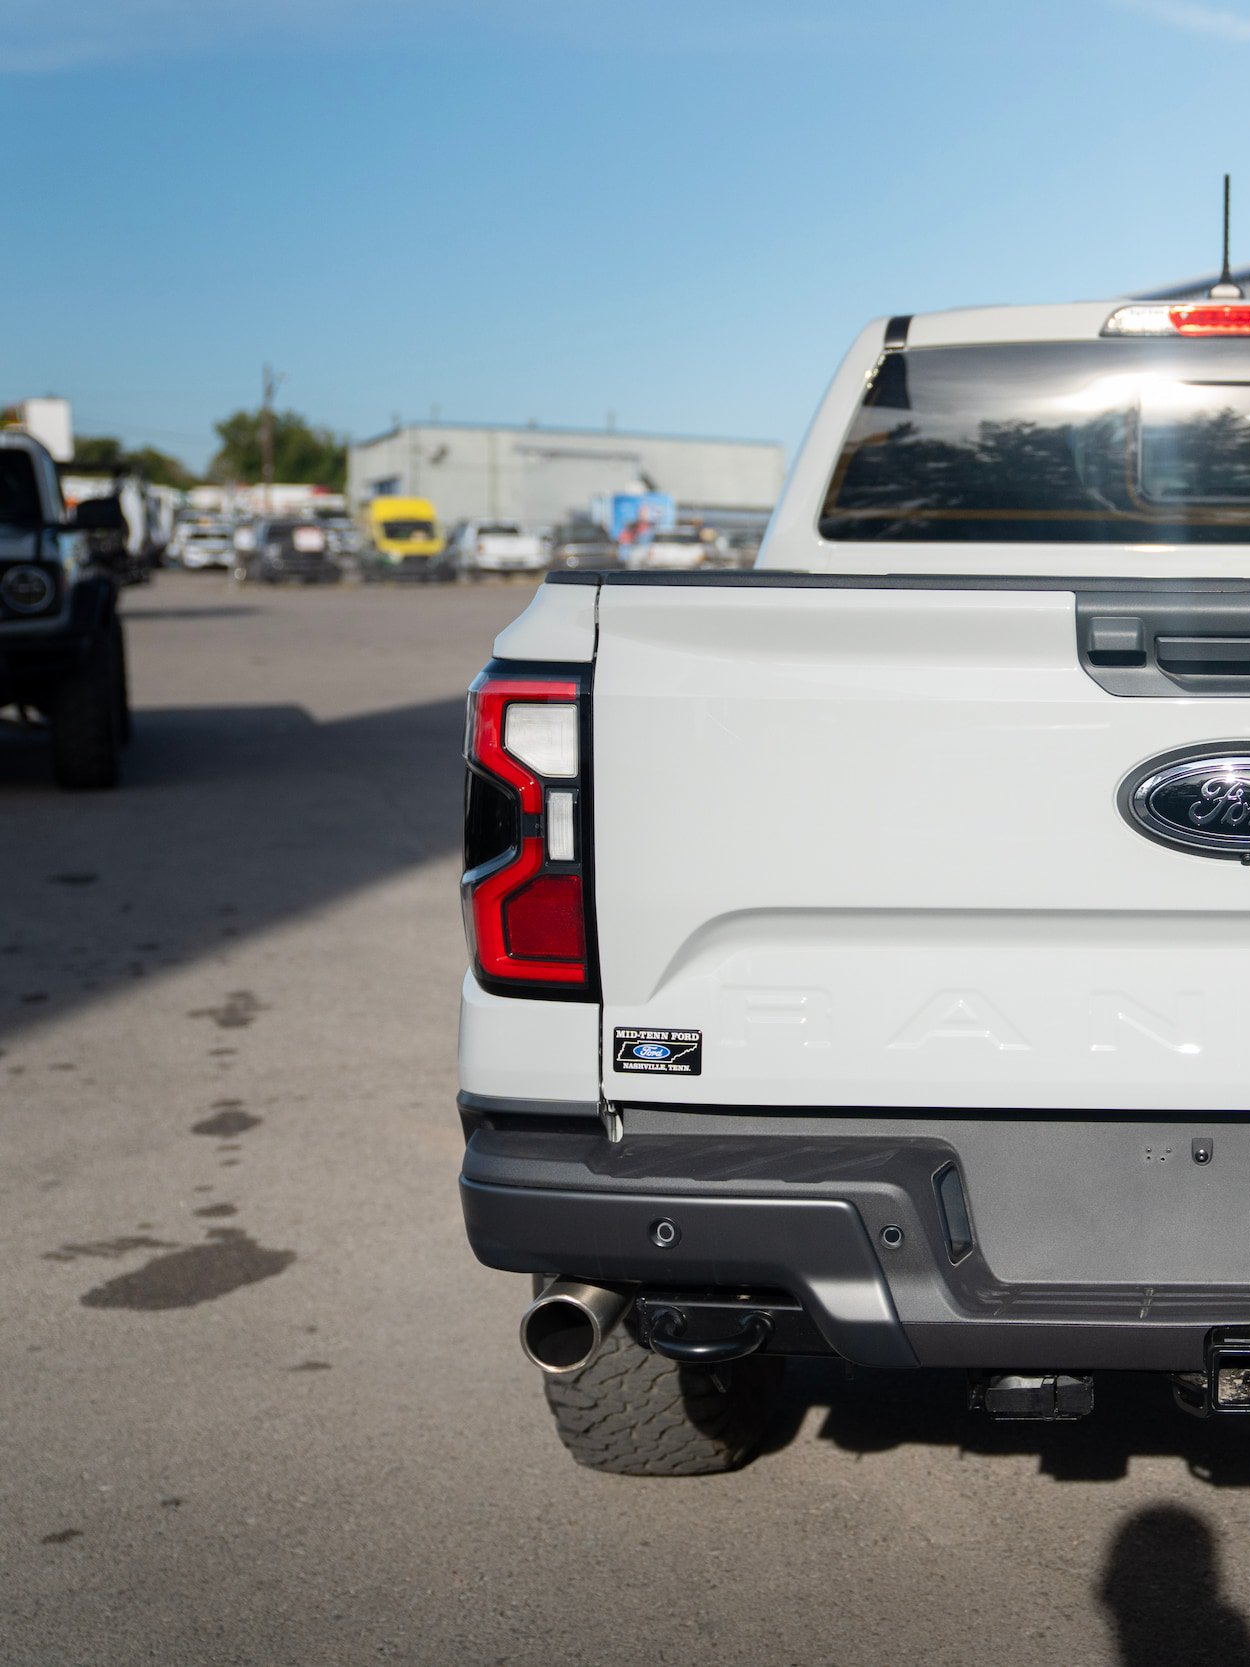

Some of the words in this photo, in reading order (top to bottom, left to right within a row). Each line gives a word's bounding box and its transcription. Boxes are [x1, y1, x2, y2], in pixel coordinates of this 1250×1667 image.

[616, 1030, 669, 1040] MID-TENN
[671, 1032, 699, 1041] FORD
[640, 1046, 663, 1056] Ford
[623, 1062, 667, 1071] NASHVILLE,
